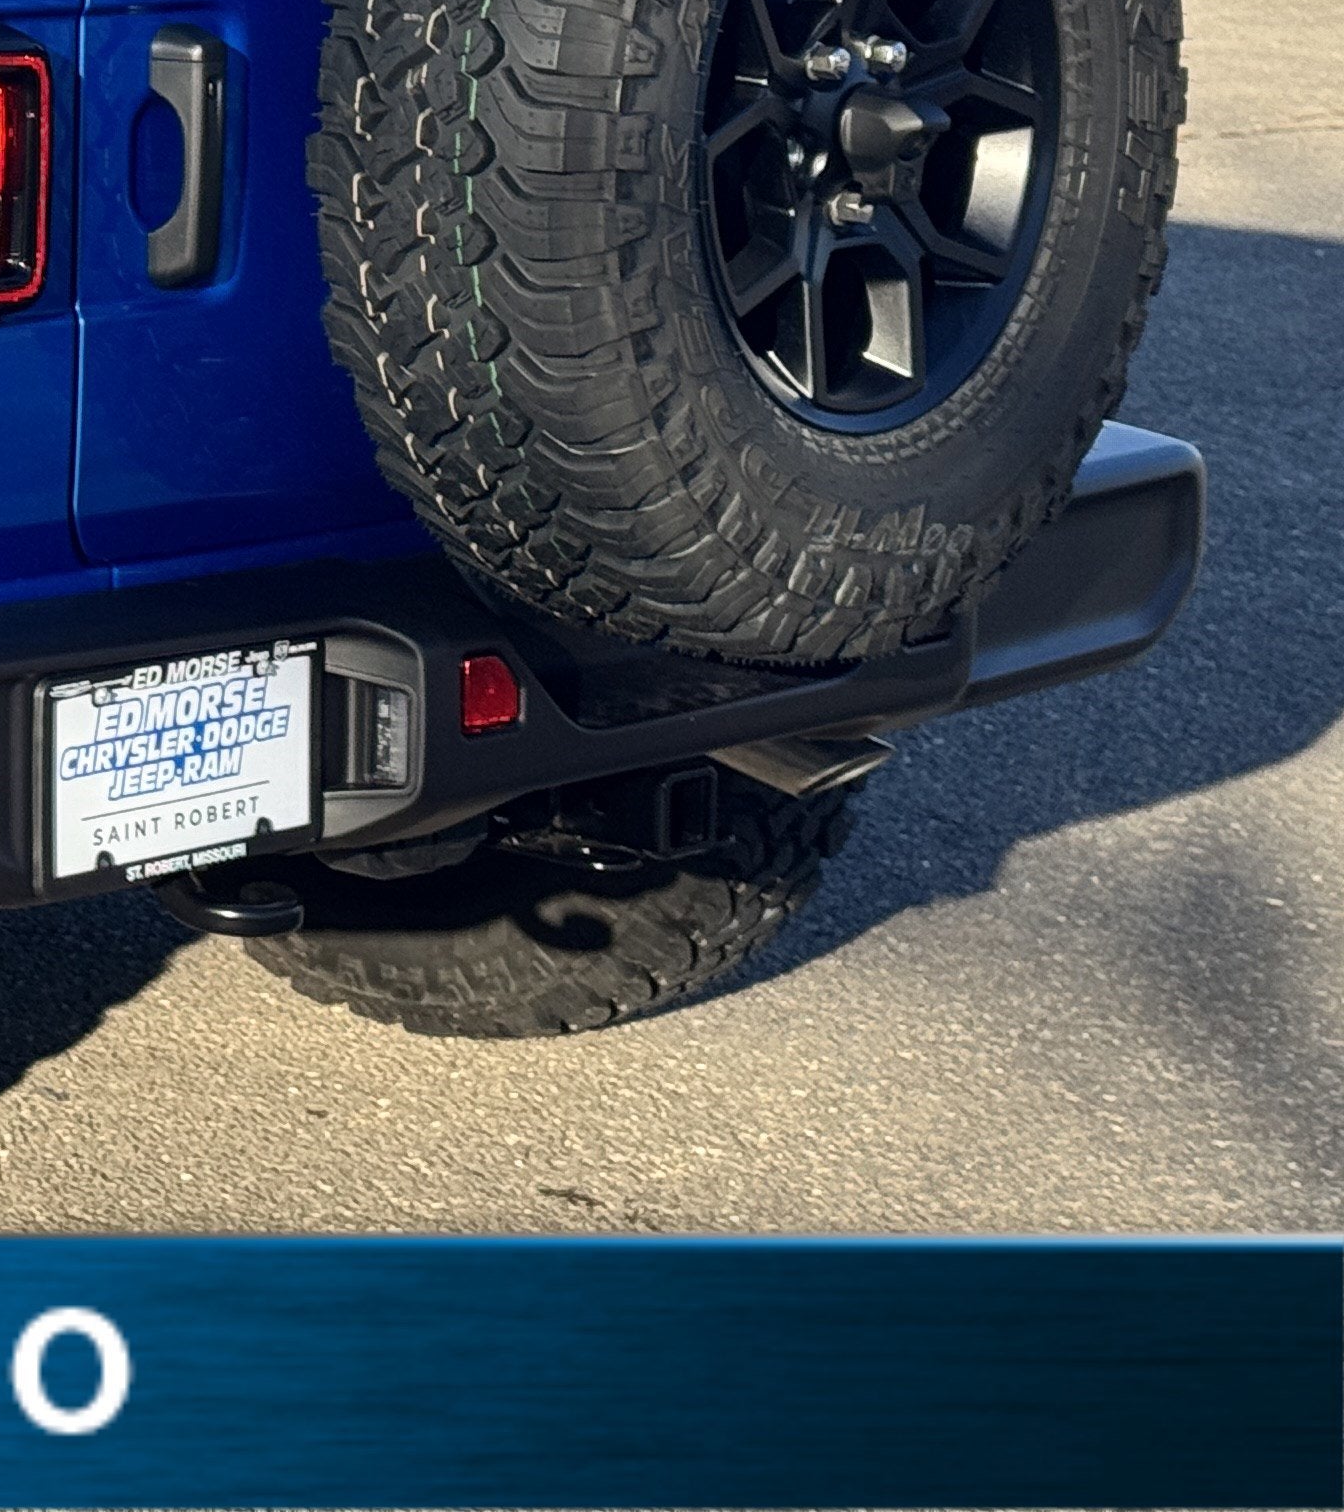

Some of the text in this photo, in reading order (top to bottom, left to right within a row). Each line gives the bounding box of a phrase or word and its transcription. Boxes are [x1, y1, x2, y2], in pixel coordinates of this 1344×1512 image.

[132, 666, 162, 689] ED
[166, 650, 242, 685] MORSE
[95, 676, 268, 742] ED MORSE
[59, 704, 292, 781] CHRYSLER DODGE
[108, 745, 245, 801] JEEP RAM
[92, 795, 260, 847] SAINT ROBERT
